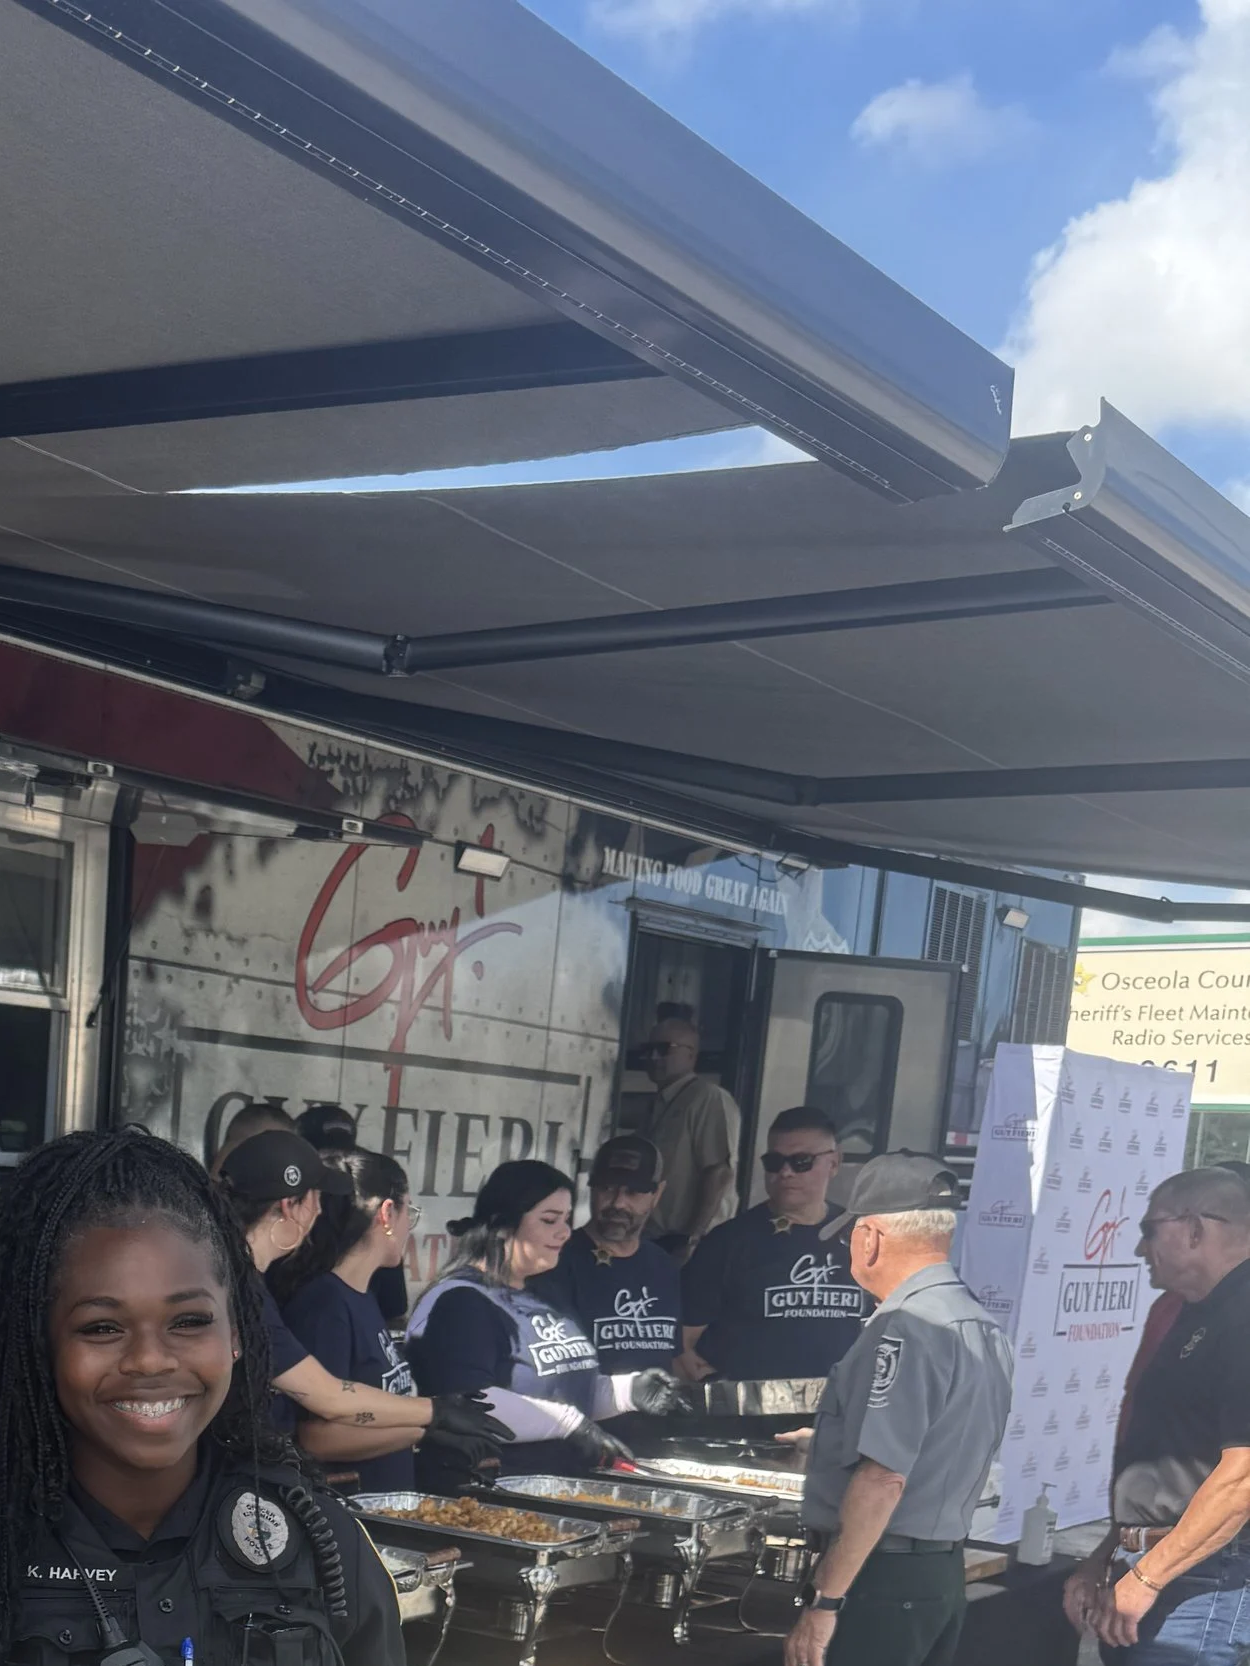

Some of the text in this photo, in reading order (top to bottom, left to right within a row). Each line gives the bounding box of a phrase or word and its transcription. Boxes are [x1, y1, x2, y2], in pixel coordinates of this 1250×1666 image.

[602, 846, 662, 886] MAKING
[665, 863, 701, 896] FOOD
[705, 873, 748, 908] GREAT
[1101, 970, 1190, 991] Osceola
[1070, 1004, 1132, 1022] heriff's
[1138, 1004, 1184, 1021] Fleet
[1112, 1029, 1250, 1046] Radio Services
[771, 1291, 859, 1307] GUY FIERI
[1063, 1280, 1134, 1313] GUY FIERI
[784, 1308, 847, 1318] FOUNDATION
[601, 1323, 676, 1339] GUY FIERI
[1068, 1323, 1120, 1342] FOUNDATION
[27, 1564, 43, 1579] K.
